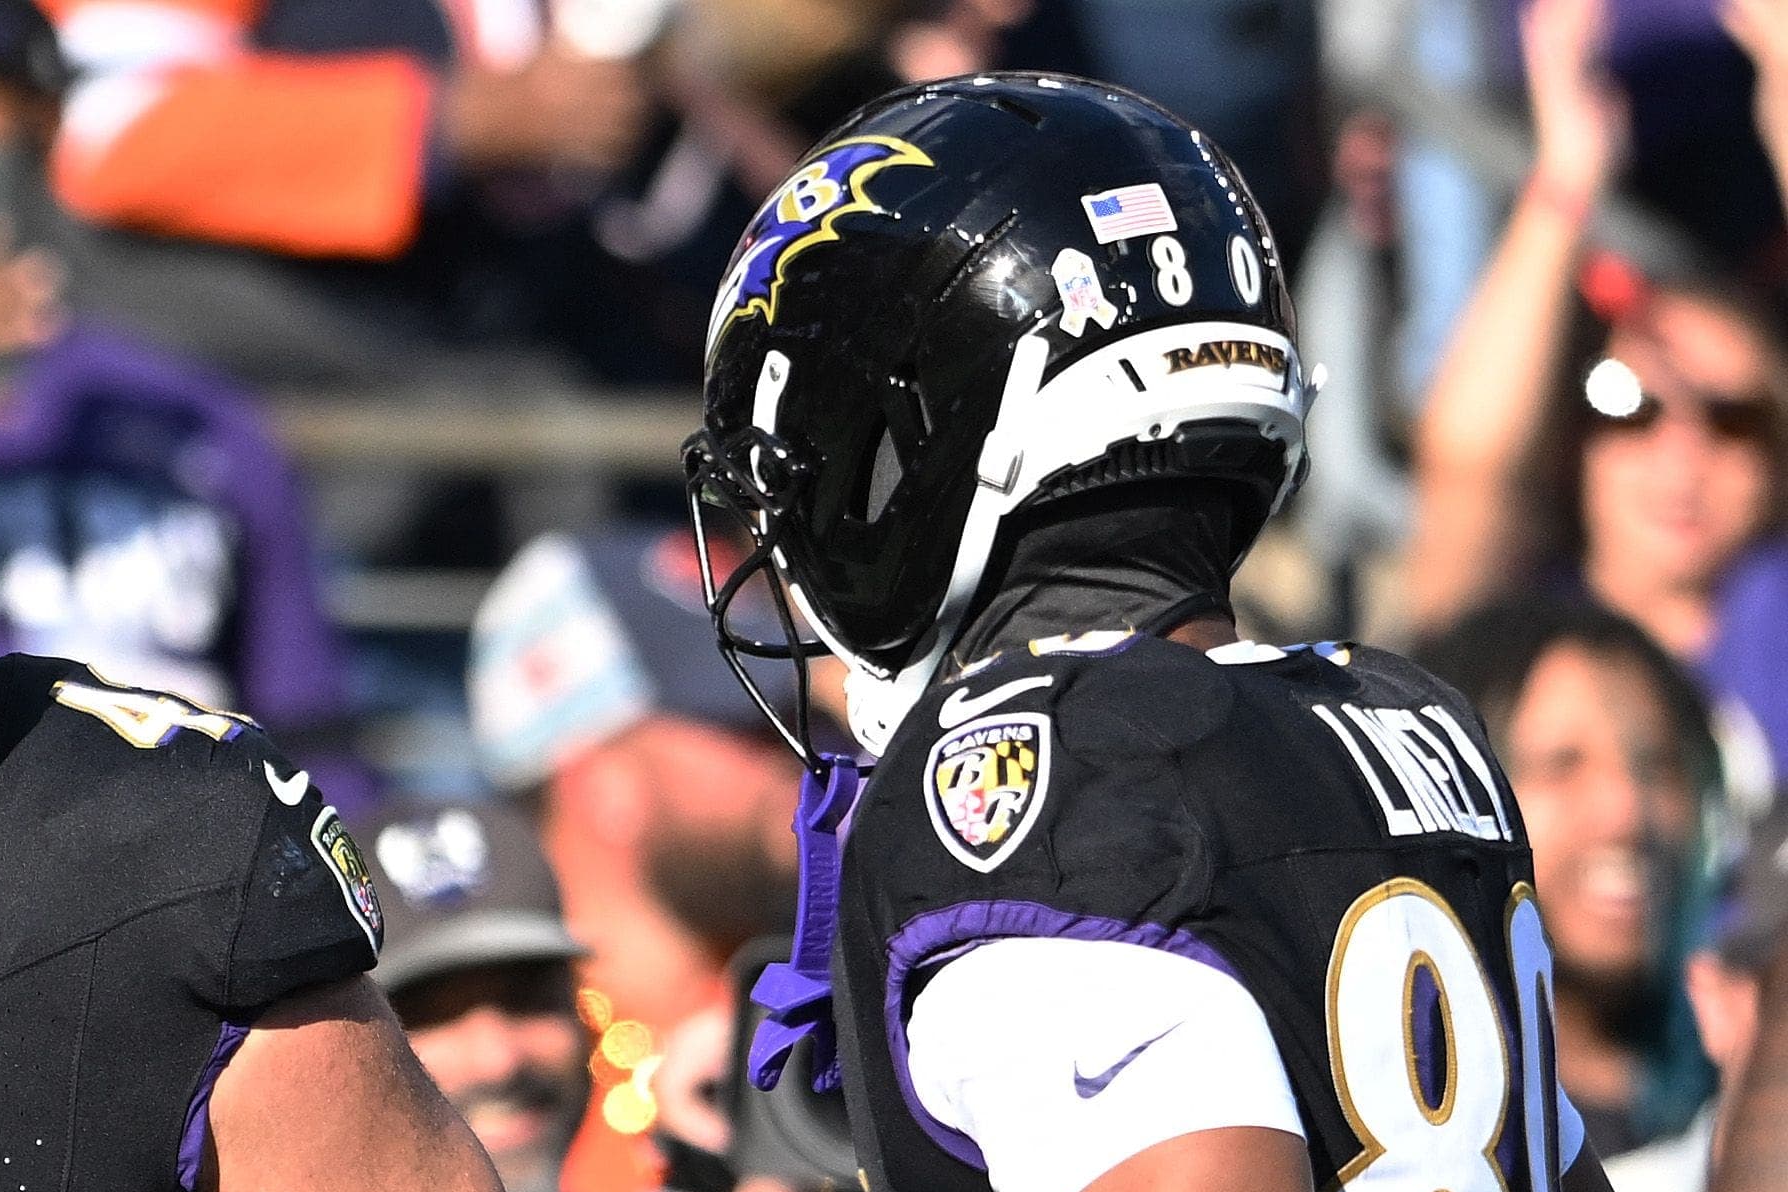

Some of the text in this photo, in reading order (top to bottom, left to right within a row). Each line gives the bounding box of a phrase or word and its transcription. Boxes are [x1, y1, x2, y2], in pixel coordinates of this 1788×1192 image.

[1146, 233, 1261, 308] 80
[1161, 340, 1287, 375] RAVENS
[942, 725, 1033, 757] RAVENS
[1311, 702, 1513, 843] LIKELY
